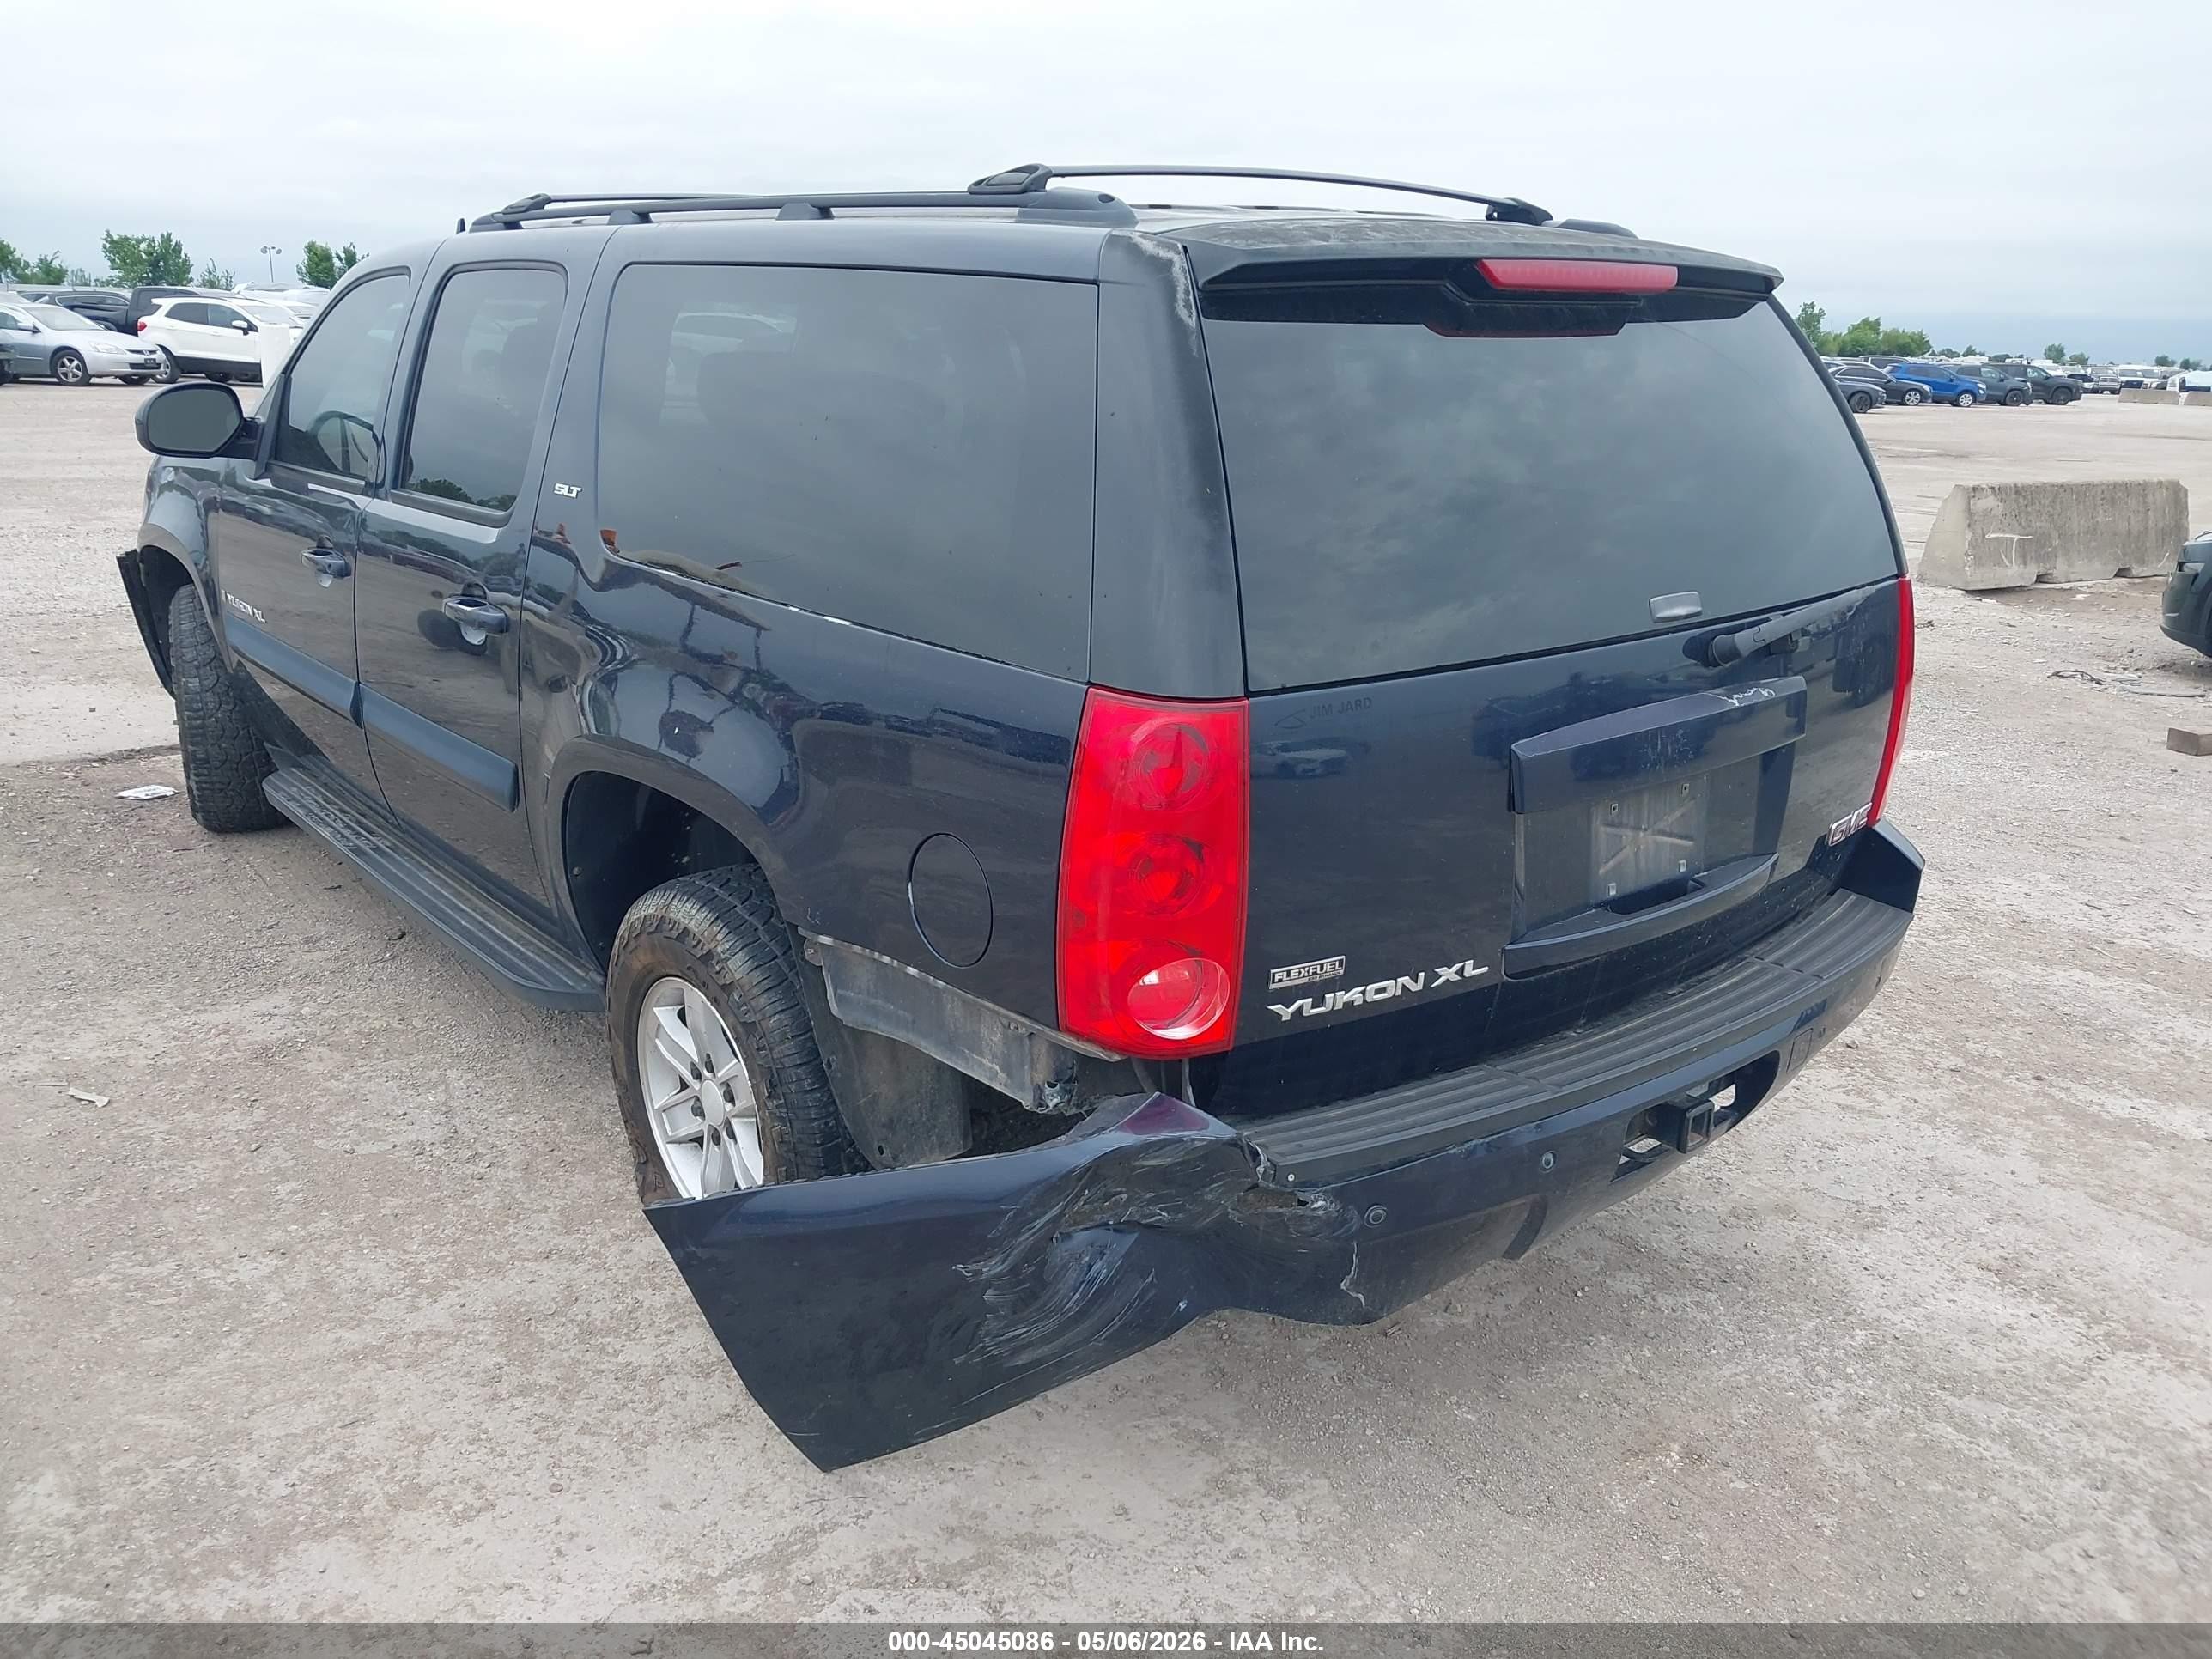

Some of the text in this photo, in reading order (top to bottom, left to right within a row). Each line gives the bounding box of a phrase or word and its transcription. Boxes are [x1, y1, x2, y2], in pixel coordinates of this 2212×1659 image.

[554, 483, 582, 498] SLT
[1274, 960, 1342, 983] FLEXFUEL
[1267, 959, 1489, 1022] YUKON XL
